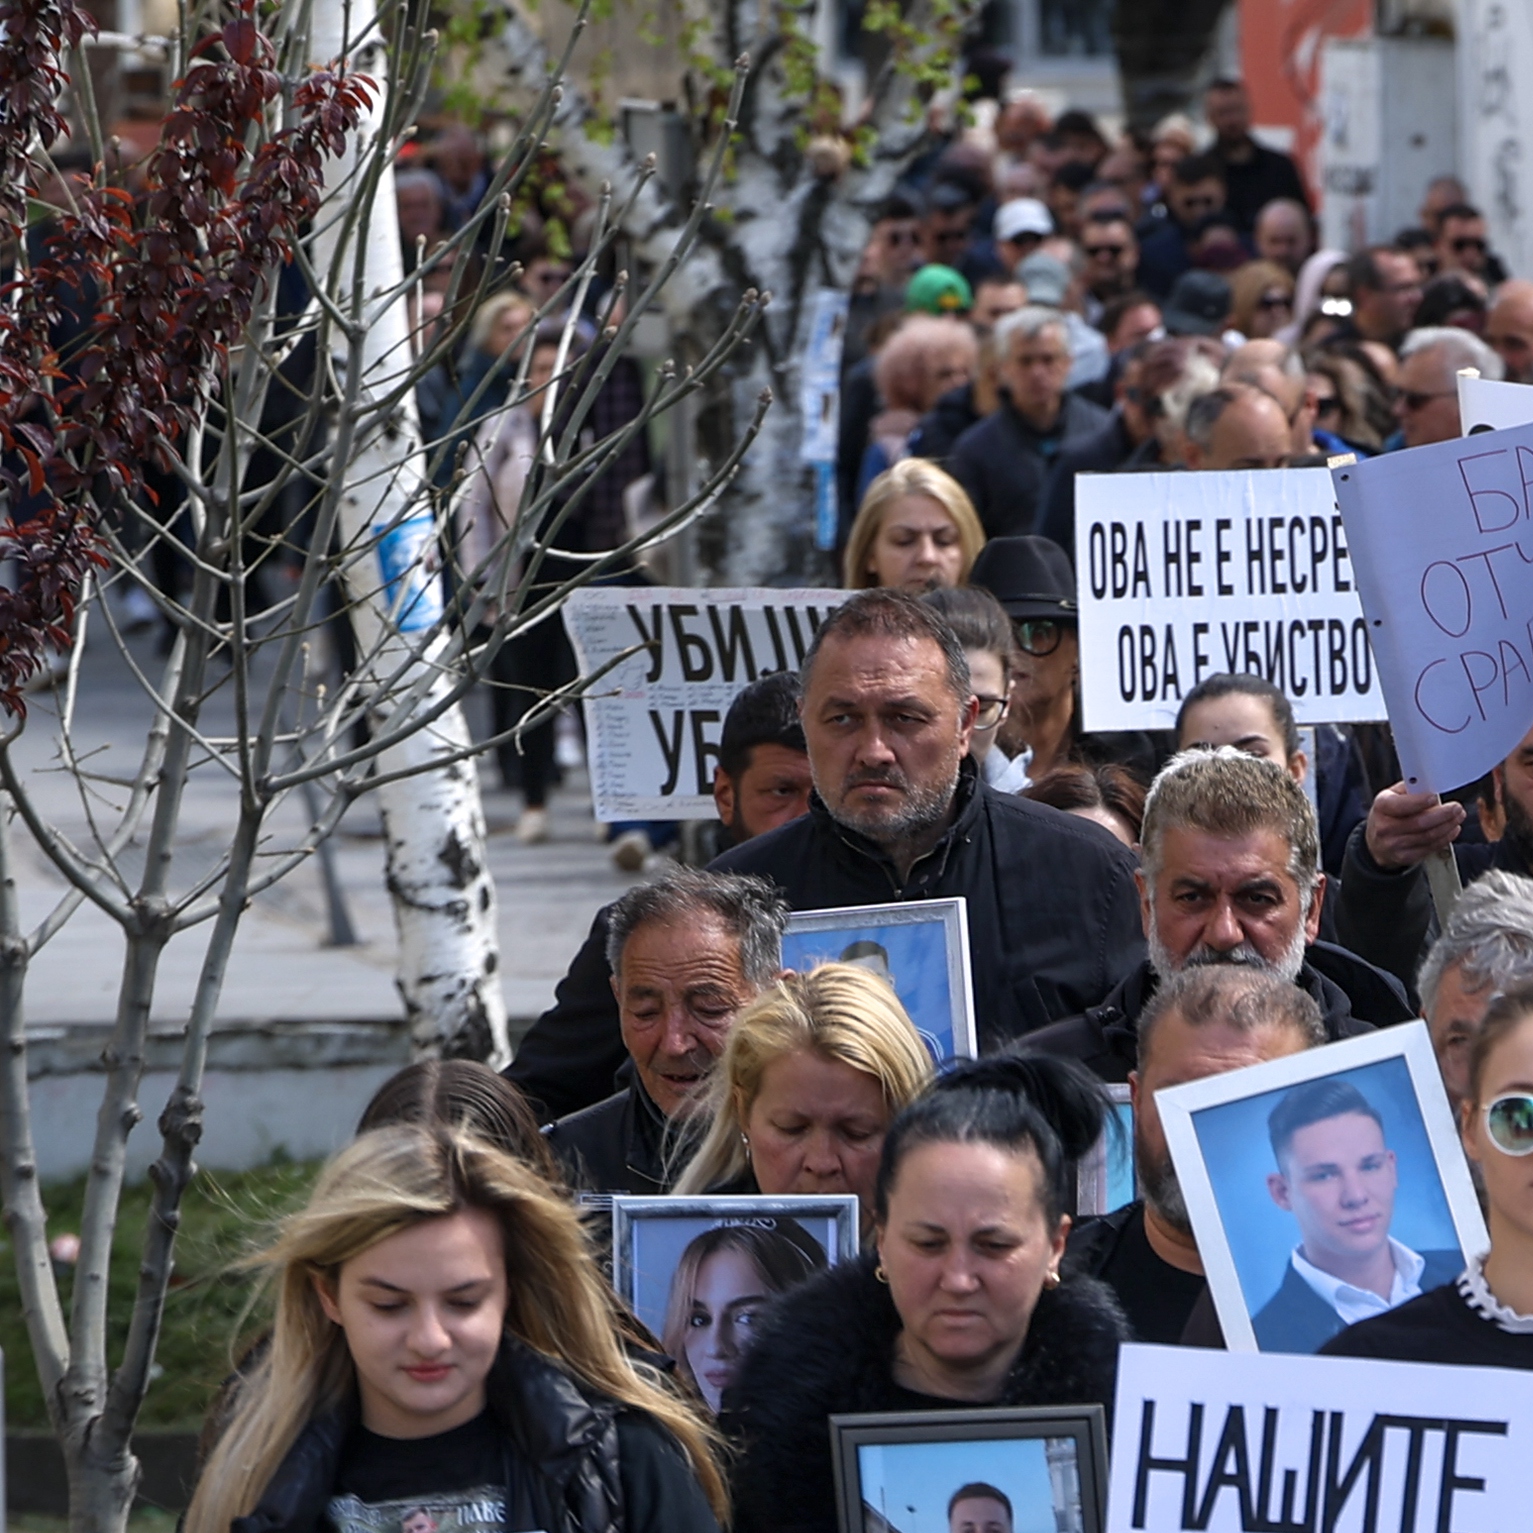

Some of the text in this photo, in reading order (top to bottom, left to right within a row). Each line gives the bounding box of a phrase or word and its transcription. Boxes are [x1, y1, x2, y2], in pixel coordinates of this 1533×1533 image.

[1089, 508, 1357, 600] ОВА НЕ Е НЕСРЕ
[1118, 623, 1183, 703] ОВА
[1220, 616, 1372, 698] УБИСТВО
